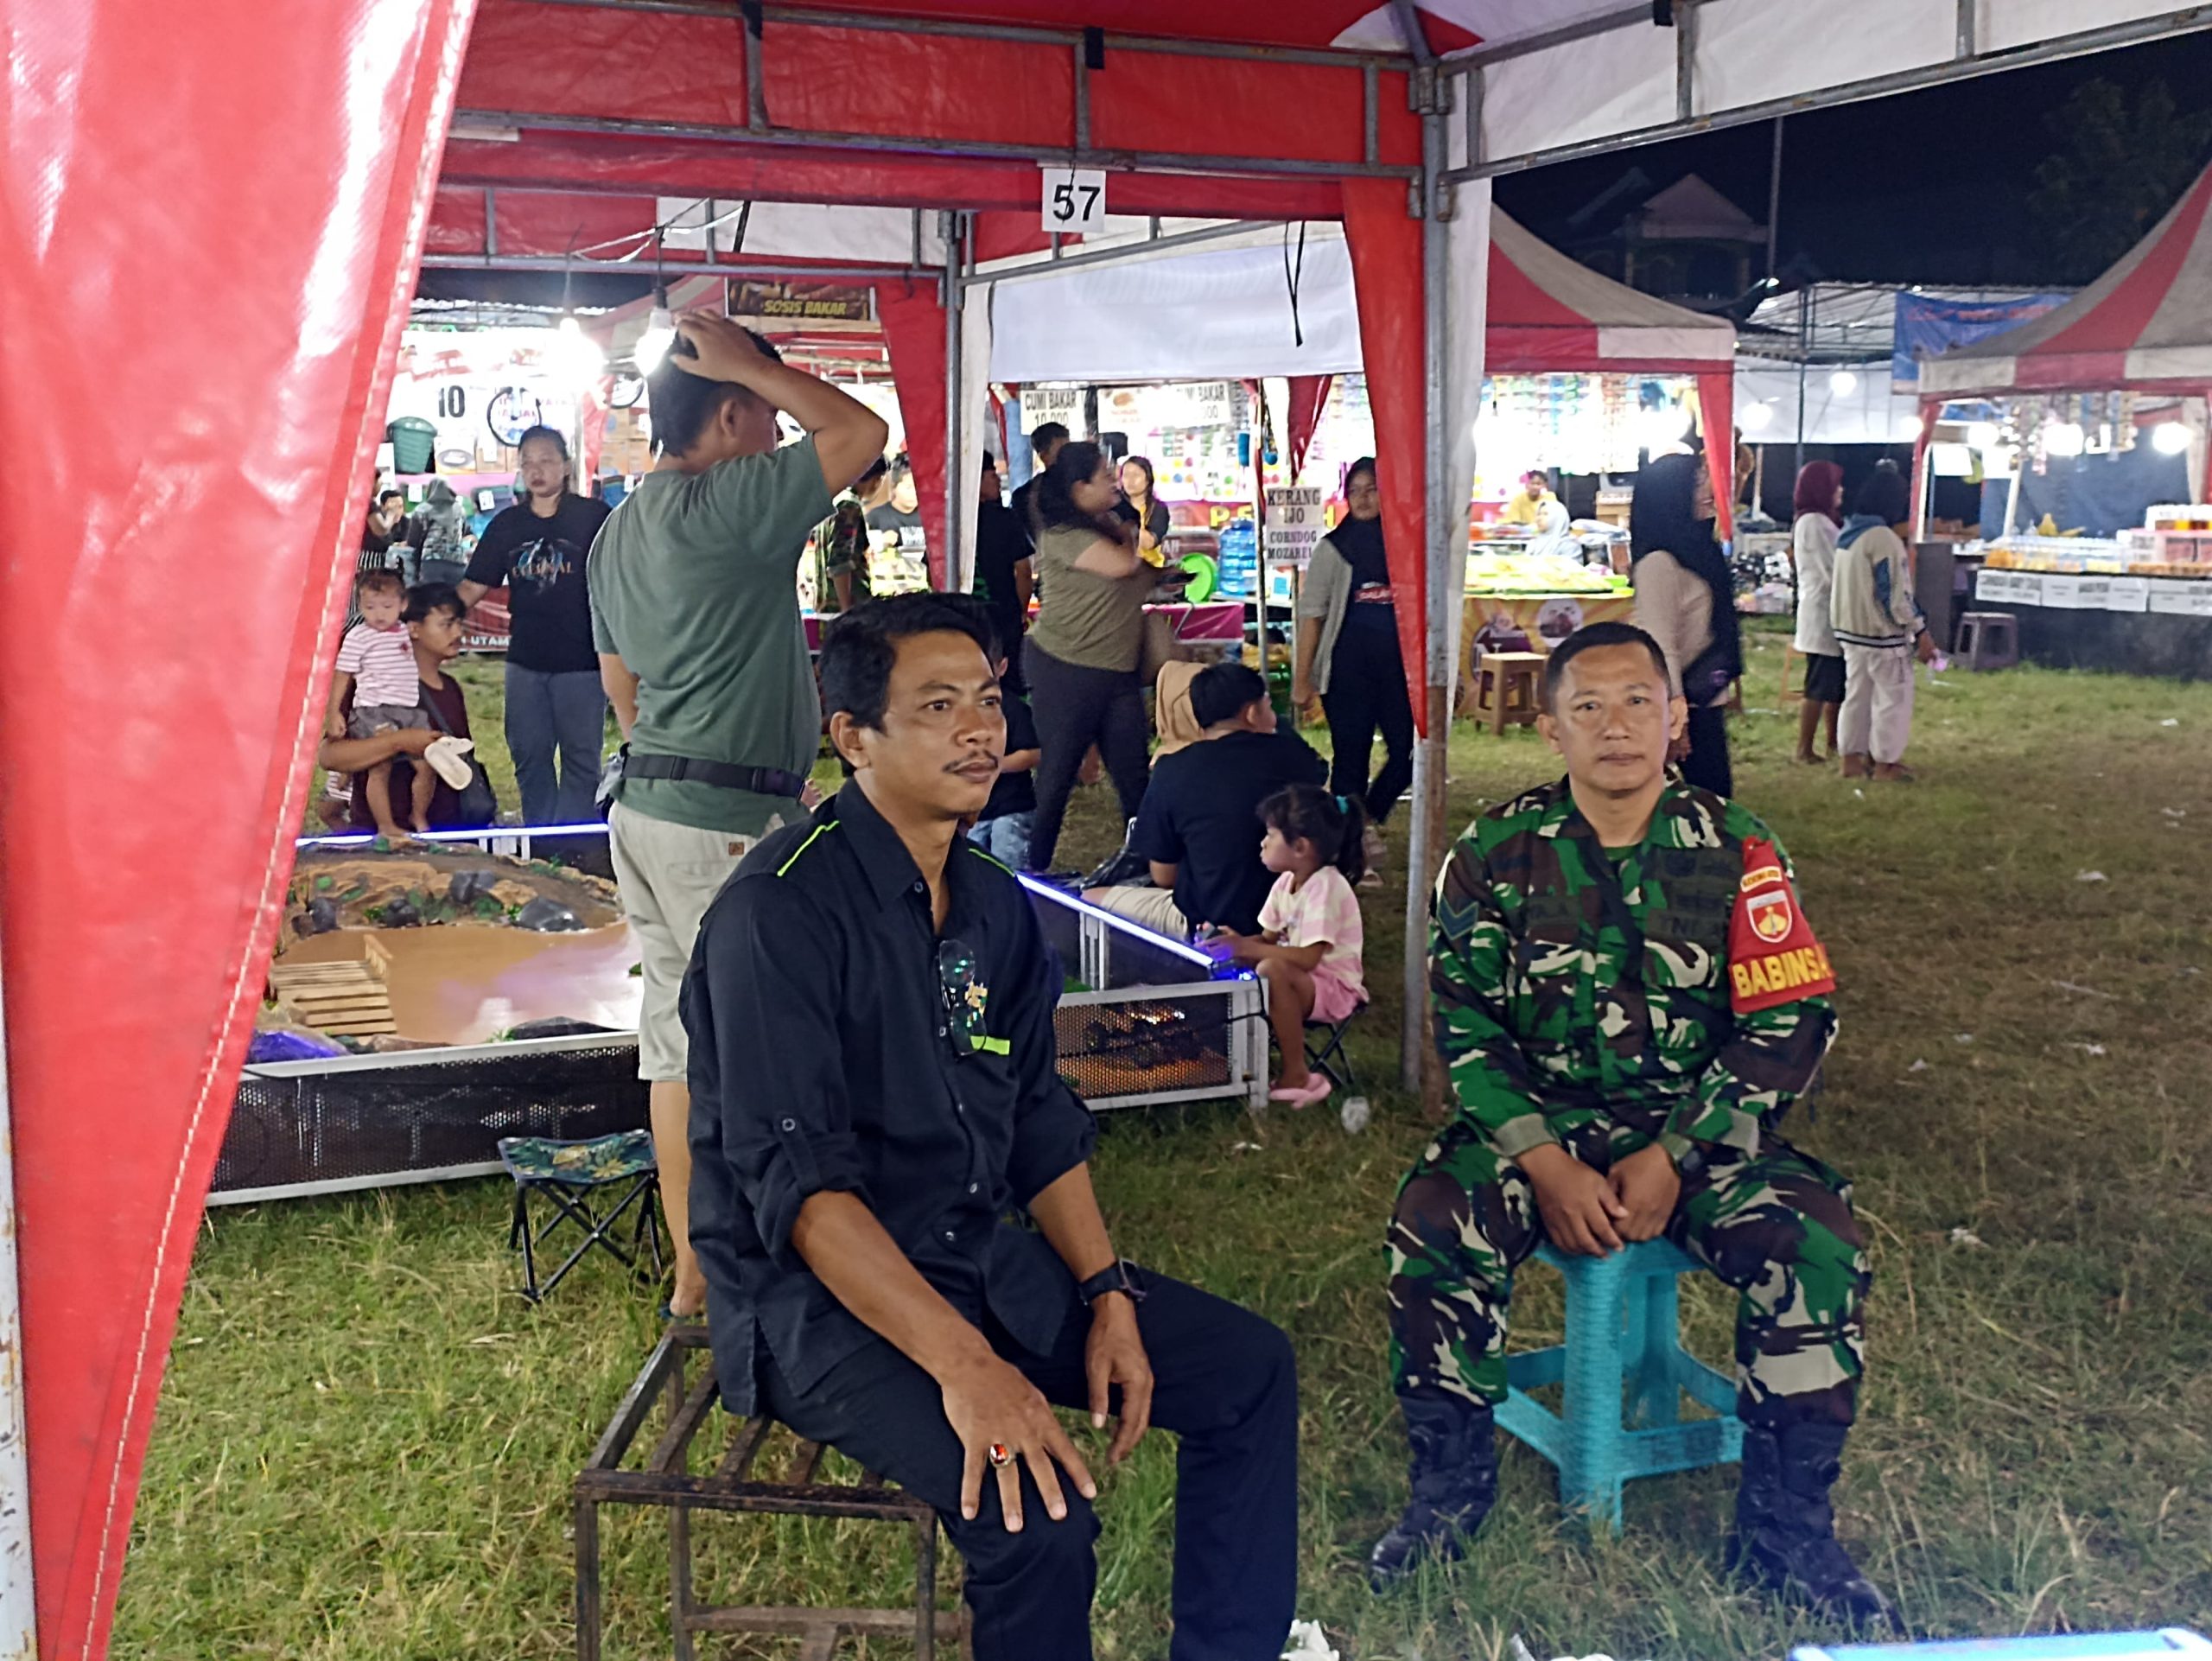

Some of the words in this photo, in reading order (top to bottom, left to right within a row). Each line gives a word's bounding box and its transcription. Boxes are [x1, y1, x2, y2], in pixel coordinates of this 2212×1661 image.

[1052, 184, 1101, 222] 57
[764, 299, 802, 314] SOSIS
[804, 302, 848, 315] BAKAR
[1025, 393, 1046, 410] CUMI
[1049, 391, 1077, 410] BAKAR
[1267, 489, 1321, 506] KERANG
[1284, 507, 1305, 525] IJO
[1270, 531, 1317, 544] CORNDOG
[1732, 943, 1834, 998] BABINSA
